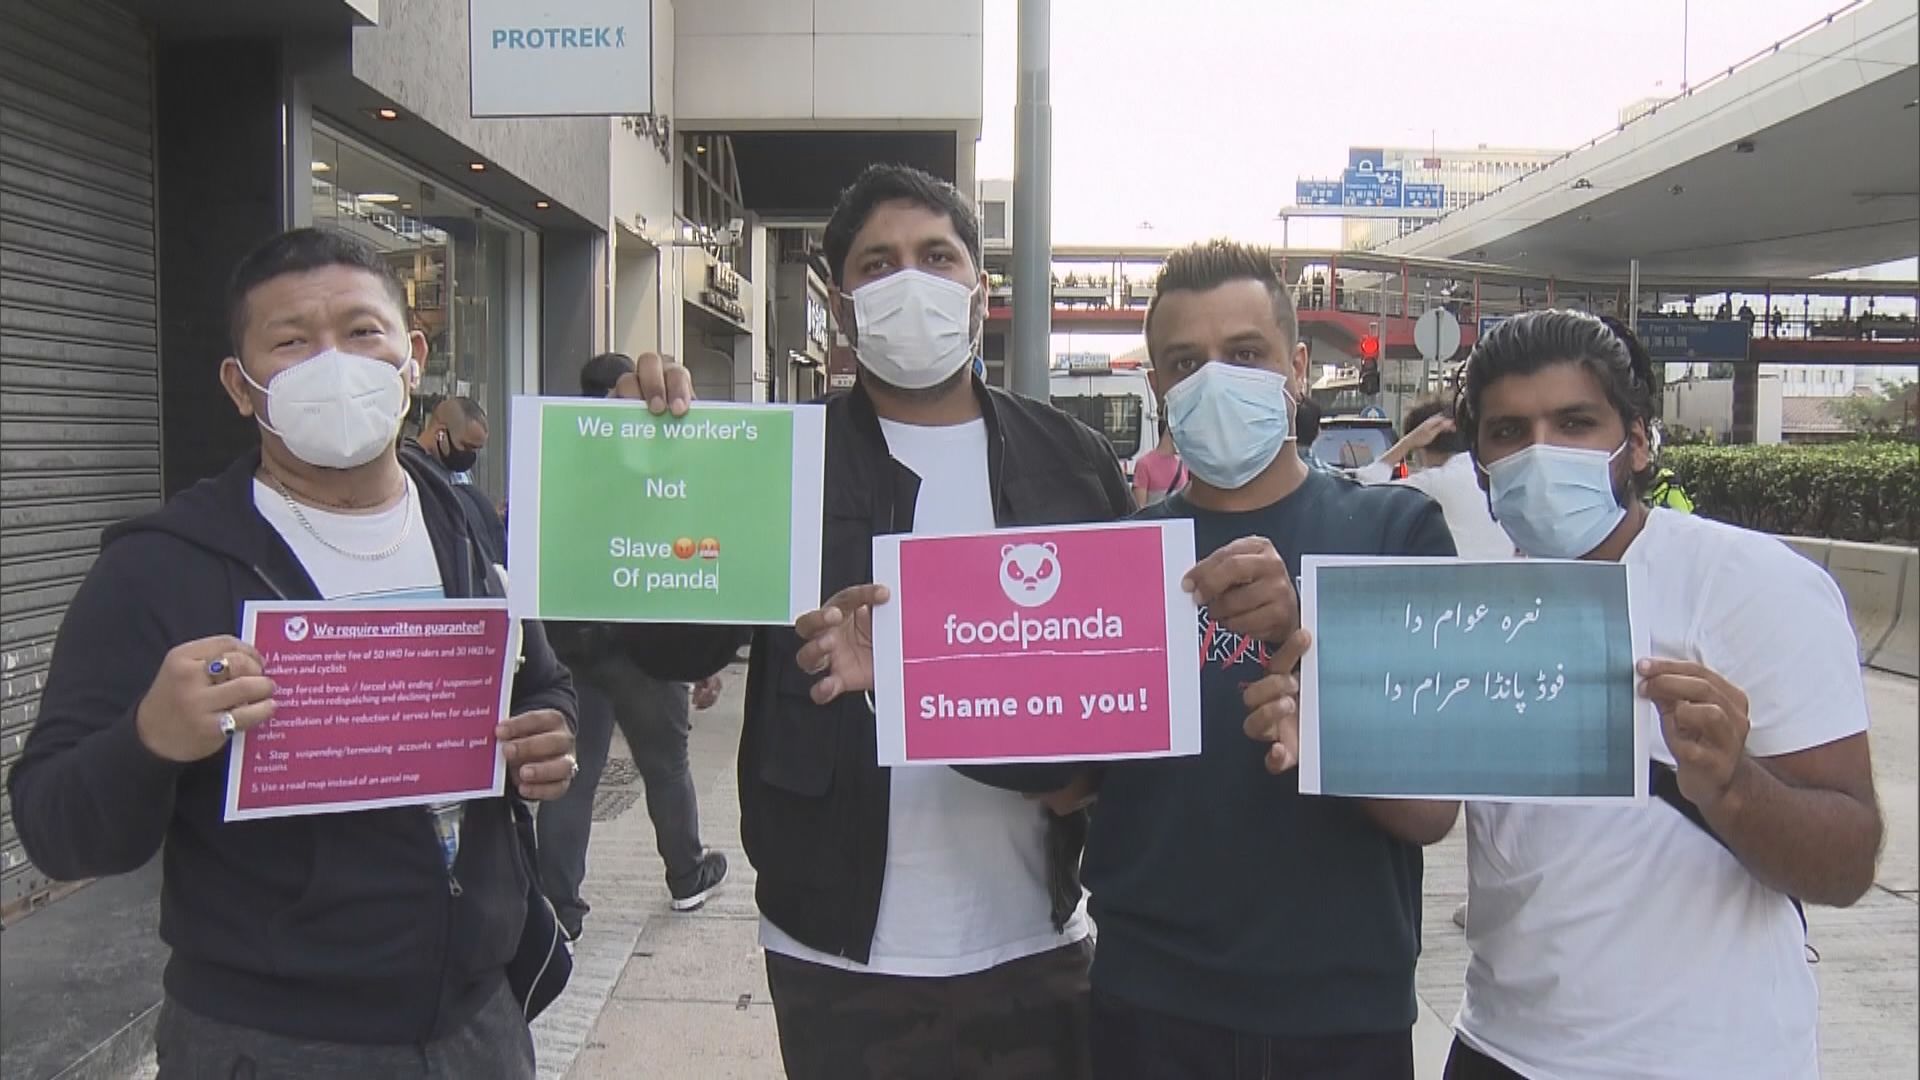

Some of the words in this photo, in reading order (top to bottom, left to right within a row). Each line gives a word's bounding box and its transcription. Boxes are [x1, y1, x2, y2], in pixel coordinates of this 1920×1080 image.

[492, 27, 610, 49] PROTREK
[577, 415, 614, 437] We
[620, 420, 656, 438] are
[663, 419, 758, 440] worker's
[646, 478, 687, 499] Not
[609, 537, 672, 558] Slave
[613, 566, 640, 588] Of
[646, 569, 717, 592] panda
[944, 607, 1123, 649] foodpanda
[1404, 602, 1423, 633] دا
[1433, 601, 1489, 649] عوام
[313, 622, 334, 636] We
[336, 623, 379, 638] require
[381, 621, 422, 635] written
[424, 620, 485, 637] guarantee!!
[272, 651, 280, 661] A
[281, 652, 322, 661] minimum
[324, 650, 346, 661] order
[348, 650, 361, 660] fee
[362, 649, 371, 659] of
[373, 649, 384, 659] 50
[386, 648, 402, 659] HKD
[404, 647, 415, 658] for
[417, 647, 439, 658] riders
[441, 647, 455, 657] and
[456, 646, 466, 656] 30
[467, 645, 483, 656] HKD
[485, 645, 495, 655] for
[264, 664, 297, 675] walkers
[299, 663, 316, 673] and
[317, 663, 347, 676] cyclists
[295, 683, 324, 694] forced
[326, 682, 349, 693] break
[359, 680, 386, 692] forced
[388, 679, 405, 690] shift
[407, 679, 433, 691] ending
[443, 677, 483, 690] suspension
[484, 675, 493, 686] of
[1385, 671, 1402, 701] دا
[1484, 671, 1527, 713] پانڈا
[1535, 663, 1564, 701] فوڈ
[301, 695, 324, 706] when
[381, 692, 396, 703] and
[397, 690, 430, 703] declining
[432, 689, 456, 700] orders
[919, 693, 1018, 719] Shame
[1027, 695, 1063, 715] on
[1080, 687, 1148, 719] you!
[1413, 671, 1470, 716] حرام
[269, 716, 322, 728] Cancellation
[324, 715, 333, 726] of
[335, 714, 349, 725] the
[351, 712, 389, 724] reduction
[391, 711, 400, 721] of
[402, 710, 429, 721] service
[431, 708, 447, 719] fees
[449, 707, 460, 718] for
[257, 730, 286, 741] orders
[269, 749, 290, 761] Stop
[398, 740, 431, 752] accounts
[436, 738, 464, 749] without
[469, 736, 488, 749] good
[254, 763, 288, 773] reasons
[261, 782, 278, 792] Use
[279, 782, 285, 791] a
[286, 780, 306, 790] road
[307, 779, 326, 791] map
[327, 776, 358, 788] instead
[358, 775, 367, 786] of
[368, 776, 378, 785] an
[380, 772, 401, 784] aerial
[402, 772, 420, 784] map
